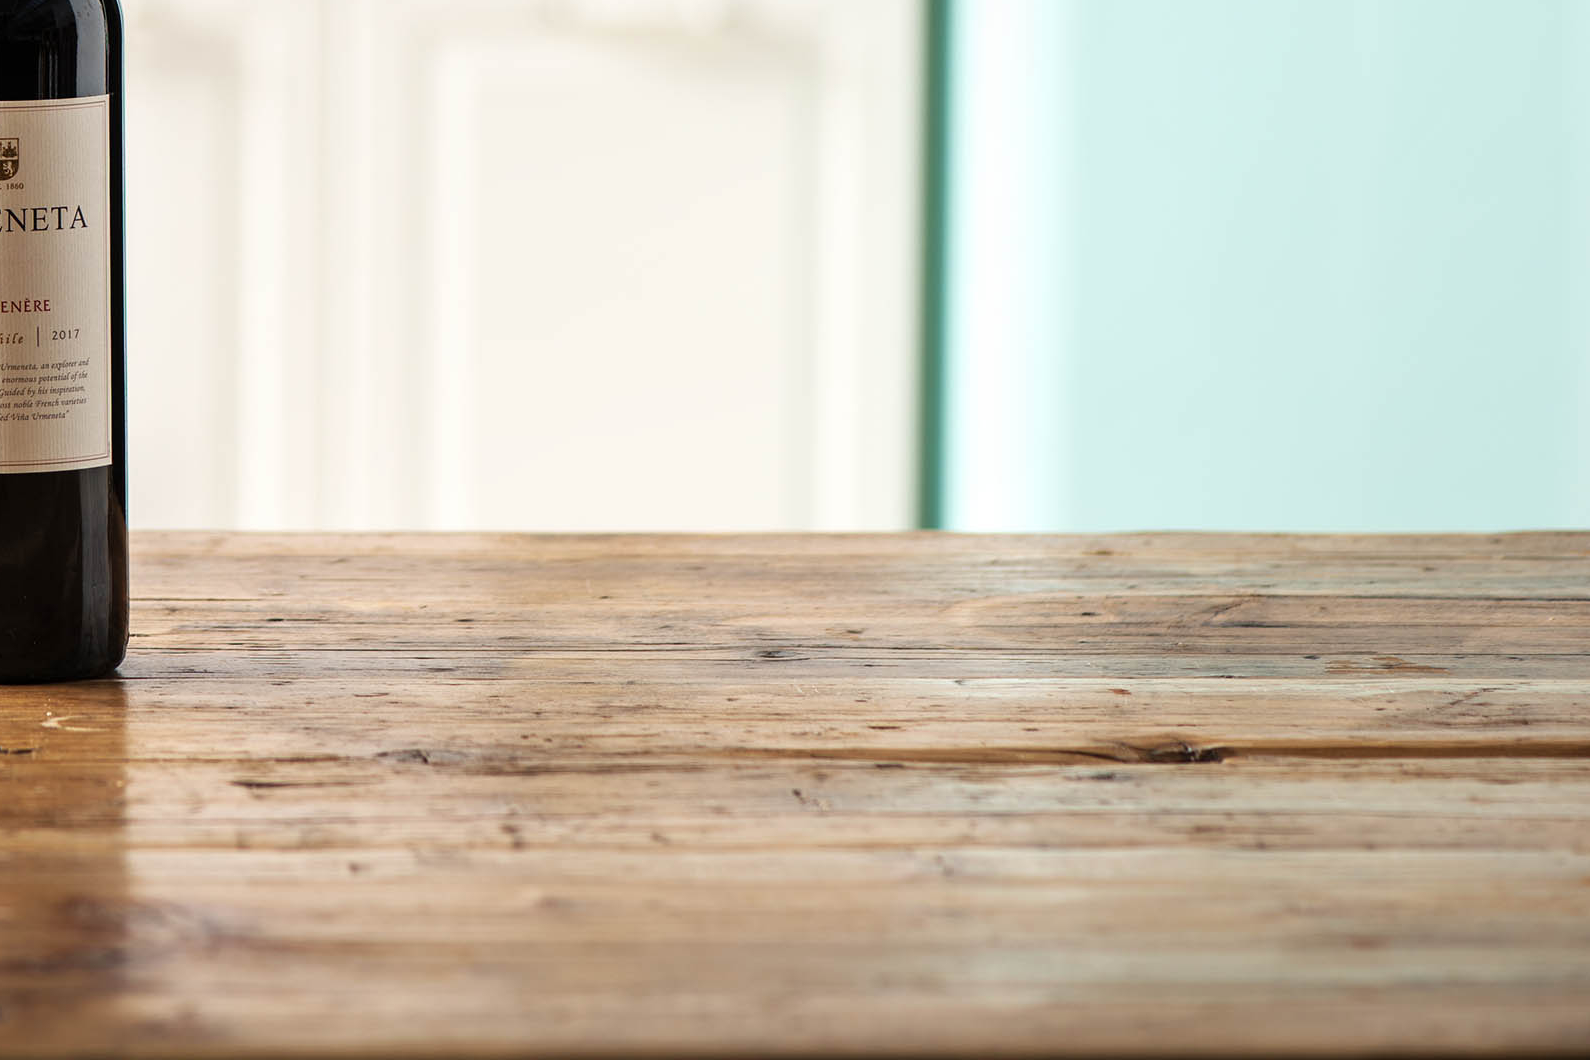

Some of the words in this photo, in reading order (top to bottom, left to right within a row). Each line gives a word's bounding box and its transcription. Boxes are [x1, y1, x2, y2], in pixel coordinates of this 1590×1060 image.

[52, 329, 80, 340] 2017
[51, 359, 77, 371] explorer
[78, 357, 90, 366] and
[2, 376, 37, 384] enormous
[38, 374, 69, 385] potential
[70, 373, 78, 382] of
[27, 387, 36, 398] by
[38, 386, 48, 395] his
[14, 399, 33, 409] noble
[35, 398, 59, 407] French
[61, 397, 87, 406] varieties
